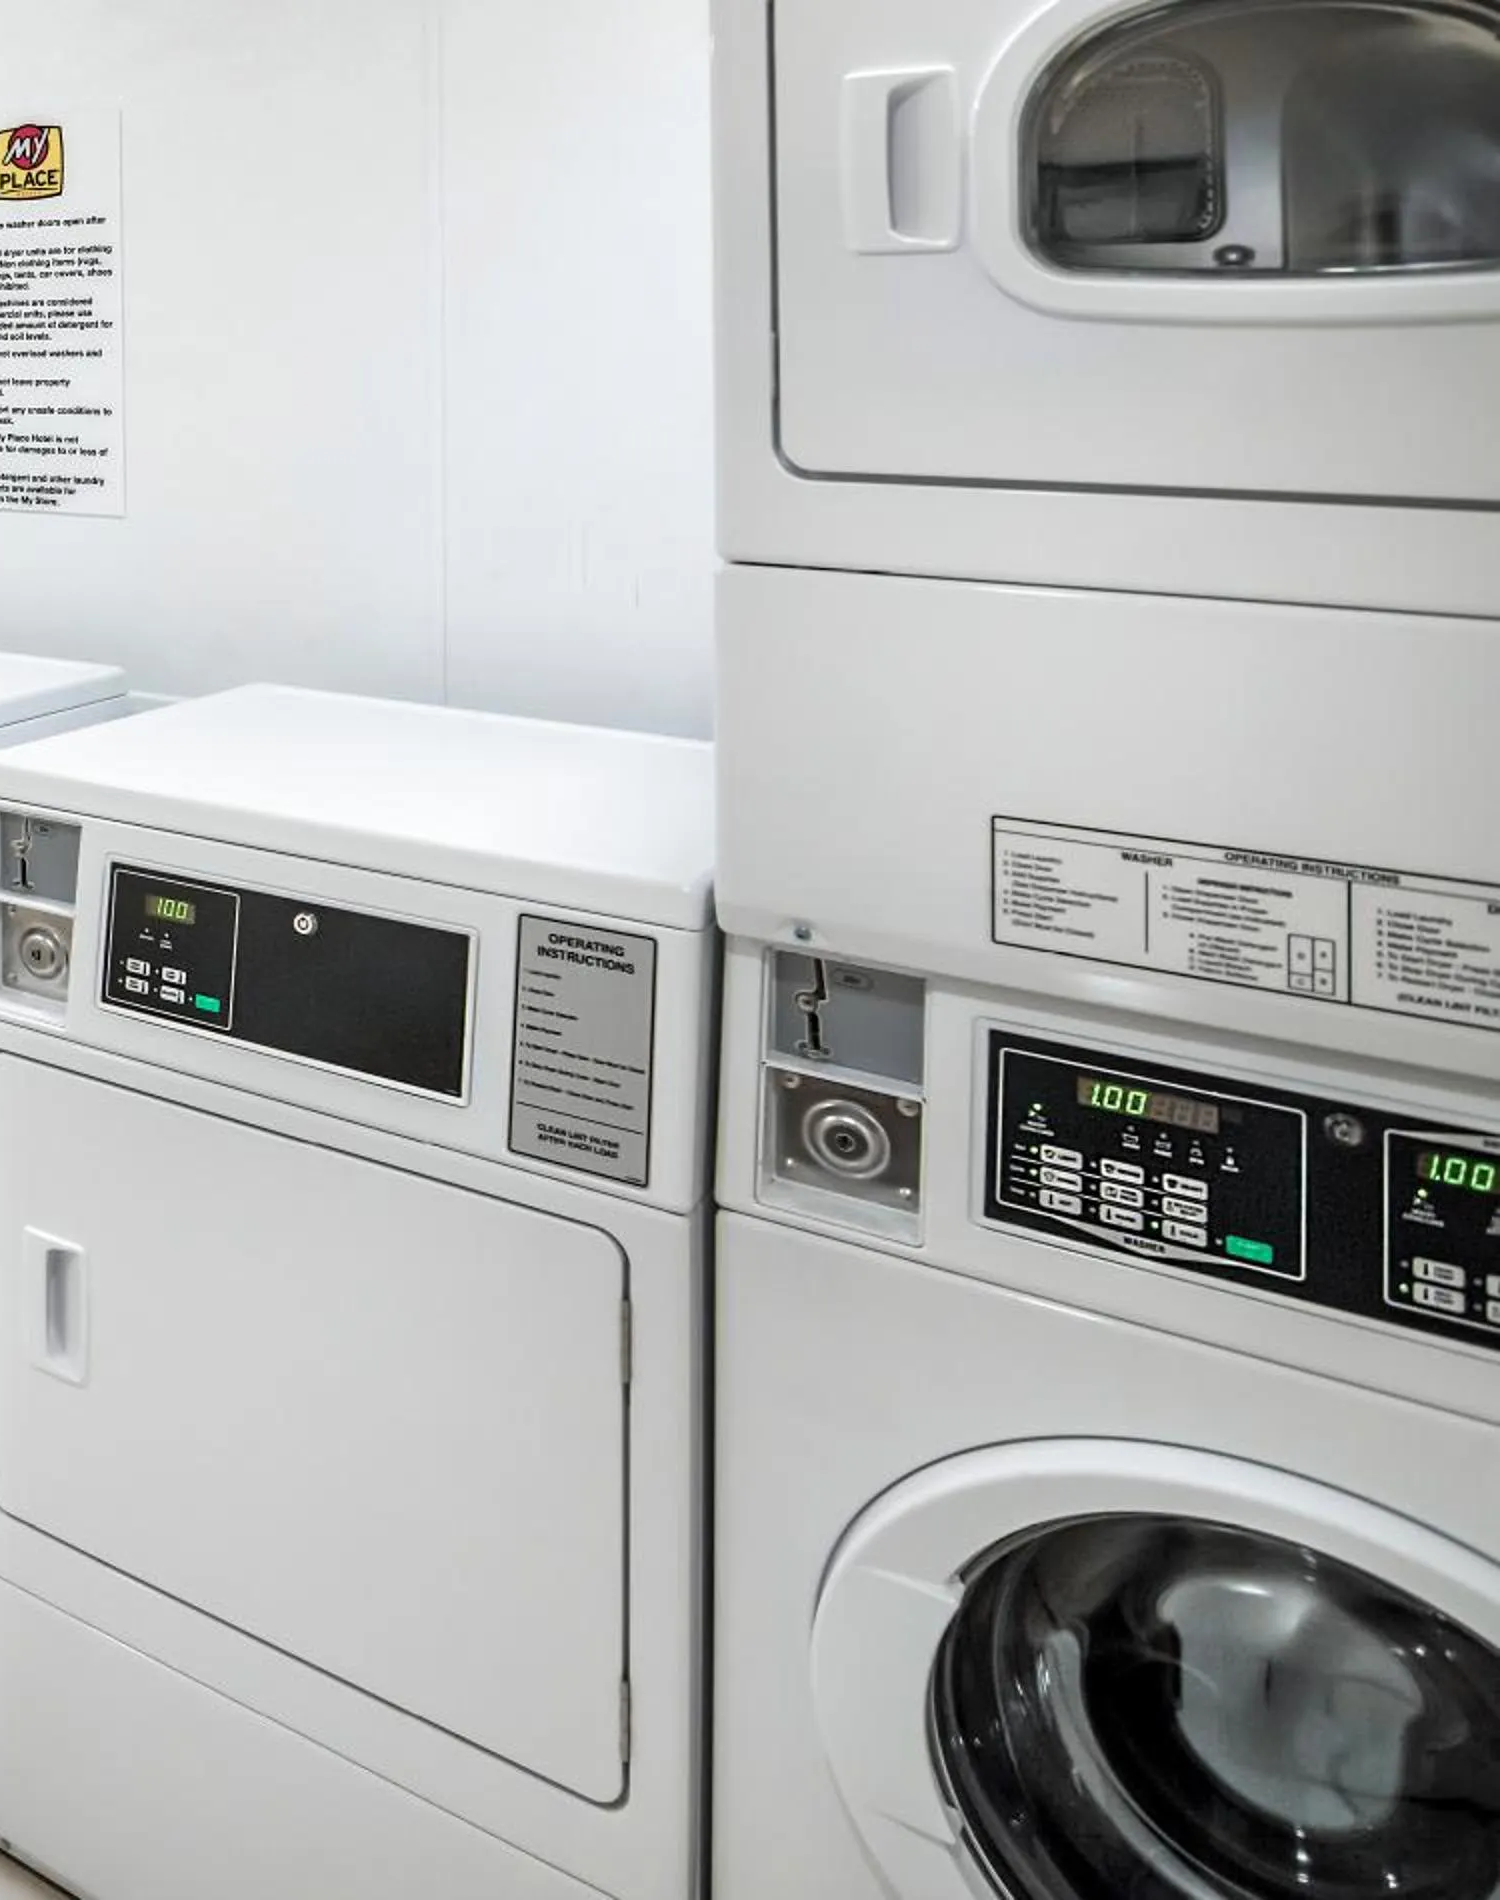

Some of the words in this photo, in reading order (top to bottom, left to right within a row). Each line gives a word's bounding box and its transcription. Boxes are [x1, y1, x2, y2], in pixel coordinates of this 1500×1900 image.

[0, 168, 60, 190] PLACE
[6, 219, 35, 229] washer
[37, 219, 61, 227] doors
[62, 218, 84, 228] open
[86, 215, 107, 225] after
[3, 248, 25, 259] dryer
[63, 245, 76, 255] for
[77, 244, 113, 255] clothing
[31, 299, 45, 307] are
[46, 297, 93, 306] considered
[15, 321, 46, 329] amount
[47, 320, 57, 329] of
[57, 320, 99, 331] detergent
[99, 319, 114, 328] for
[11, 349, 47, 358] overload
[49, 349, 84, 358] washers
[85, 348, 103, 358] and
[11, 377, 33, 386] leave
[35, 378, 71, 388] property
[11, 407, 26, 416] any
[27, 405, 55, 415] unsafe
[57, 405, 101, 416] conditions
[103, 407, 113, 416] to
[7, 433, 30, 442] Place
[31, 433, 54, 443] Hotel
[56, 434, 63, 443] is
[63, 435, 79, 444] not
[31, 475, 48, 483] and
[49, 475, 72, 484] other
[73, 475, 105, 488] laundry
[1121, 851, 1173, 867] WASHER
[1224, 851, 1298, 871] OPERATING
[1301, 862, 1400, 885] INSTRUCTIONS
[548, 933, 625, 957] OPERATING
[537, 945, 635, 975] INSTRUCTIONS
[1091, 1083, 1148, 1115] 1.00
[1429, 1154, 1496, 1192] 1.00
